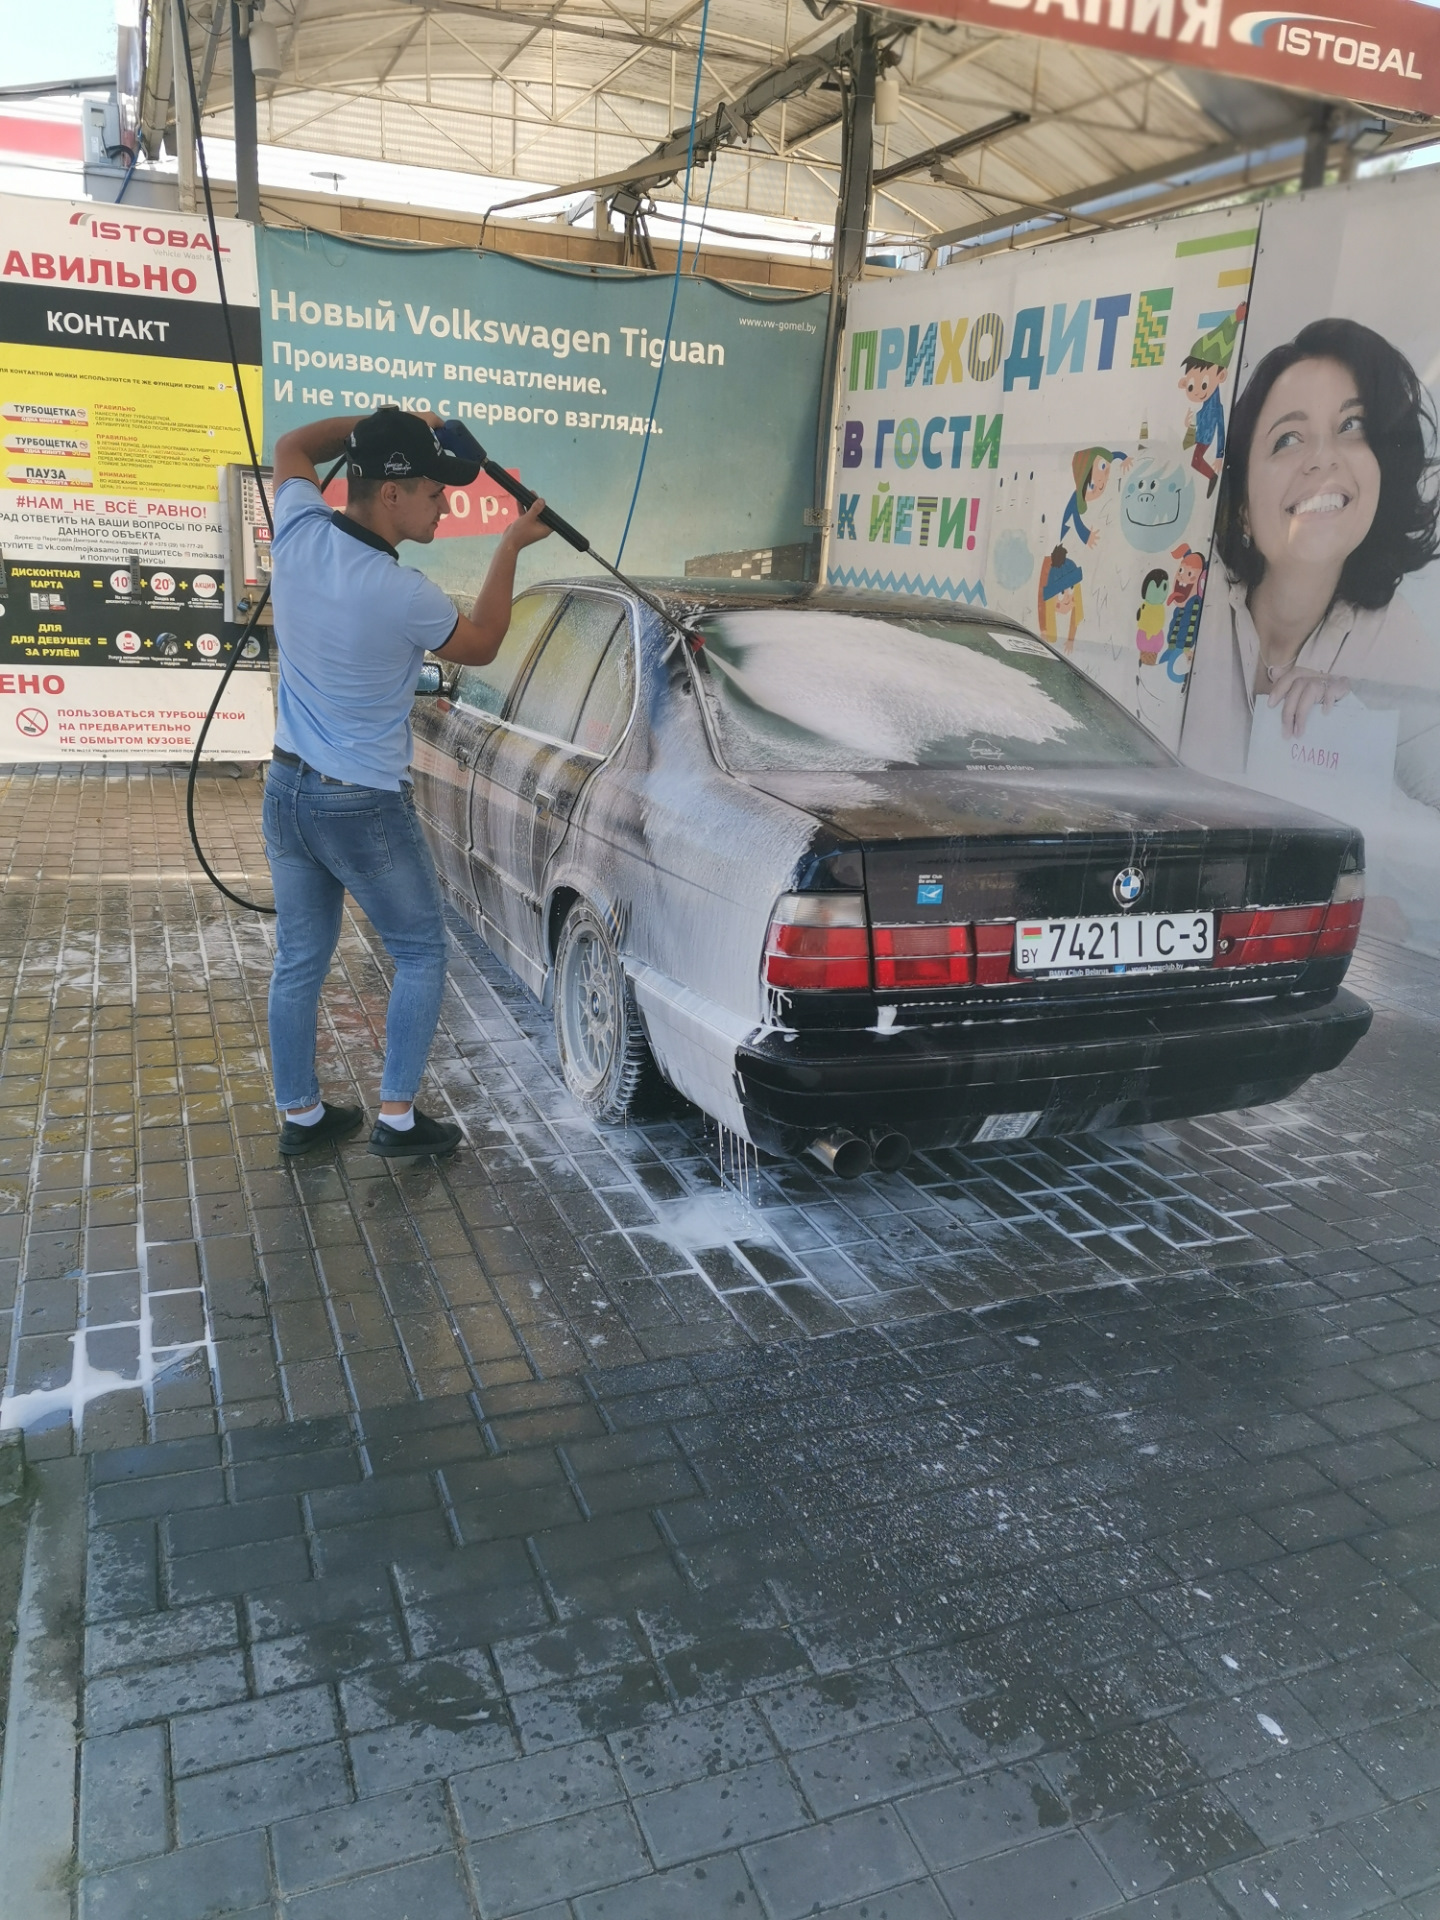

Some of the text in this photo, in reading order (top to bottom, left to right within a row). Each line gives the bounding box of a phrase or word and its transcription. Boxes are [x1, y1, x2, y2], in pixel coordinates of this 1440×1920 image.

[1278, 24, 1423, 80] ISTOBAL
[92, 221, 231, 253] ISTOBAL
[153, 248, 182, 258] Vehicle
[184, 251, 204, 261] Wash
[3, 250, 197, 294] АВИЛЬНО
[47, 310, 170, 342] КОНТАКТ
[270, 289, 725, 368] Новый Volkswagen Tiguan
[739, 317, 816, 334] www.vw-gomel.by
[849, 287, 1174, 392] ПРИХОДИТЕ
[272, 341, 607, 395] Производит впечатление.
[10, 369, 53, 377] КОНТАКТНОЙ
[79, 374, 131, 383] ИСПОЛЬЗУЮТСЯ
[14, 404, 77, 417] ТУРБОЩЕТКА
[94, 403, 136, 412] ПРАВИЛЬНО
[274, 379, 663, 435] И не только с первого взгляда.
[15, 437, 78, 449] ТУРБОЩЕТКА
[96, 433, 138, 442] ПРАВИЛЬНО
[842, 413, 1004, 470] В ГОСТИ
[26, 467, 66, 480] ПАУЗА
[99, 471, 137, 479] ВНИМАНИЕ
[16, 495, 207, 519] #НАМ_НЕ_ВСЁ_РАВНО!
[480, 496, 509, 524] р.
[837, 481, 981, 551] К ЙЕТИ!
[21, 514, 78, 525] ОТВЕТИТЬ
[81, 517, 95, 526] НА
[98, 518, 130, 528] ВАШИ
[132, 520, 185, 531] ВОПРОСЫ
[187, 523, 203, 532] ПО
[58, 527, 161, 540] ДАННОГО ОБЪЕКТА
[87, 555, 130, 564] ПОЛУЧИТЕ
[11, 567, 81, 578] ДИСКОНТНАЯ
[31, 580, 64, 589] КАРТА
[38, 623, 62, 633] ДЛЯ
[11, 635, 91, 645] ДЛЯ ДЕВУШЕК
[25, 647, 80, 657] ЗА РУЛЁМ
[0, 673, 65, 695] ЕНО
[57, 709, 155, 718] ПОЛЬЗОВАТЬСЯ
[59, 723, 191, 732] НА ПРЕДВАРИТЕЛЬНО
[60, 736, 195, 745] НЕ ОБМЫТОМ КУЗОВЕ.
[1021, 948, 1038, 964] BY
[1048, 921, 1120, 962] 7421
[1049, 969, 1068, 977] BMW
[1068, 969, 1084, 977] Club
[1085, 968, 1110, 976] Belarus
